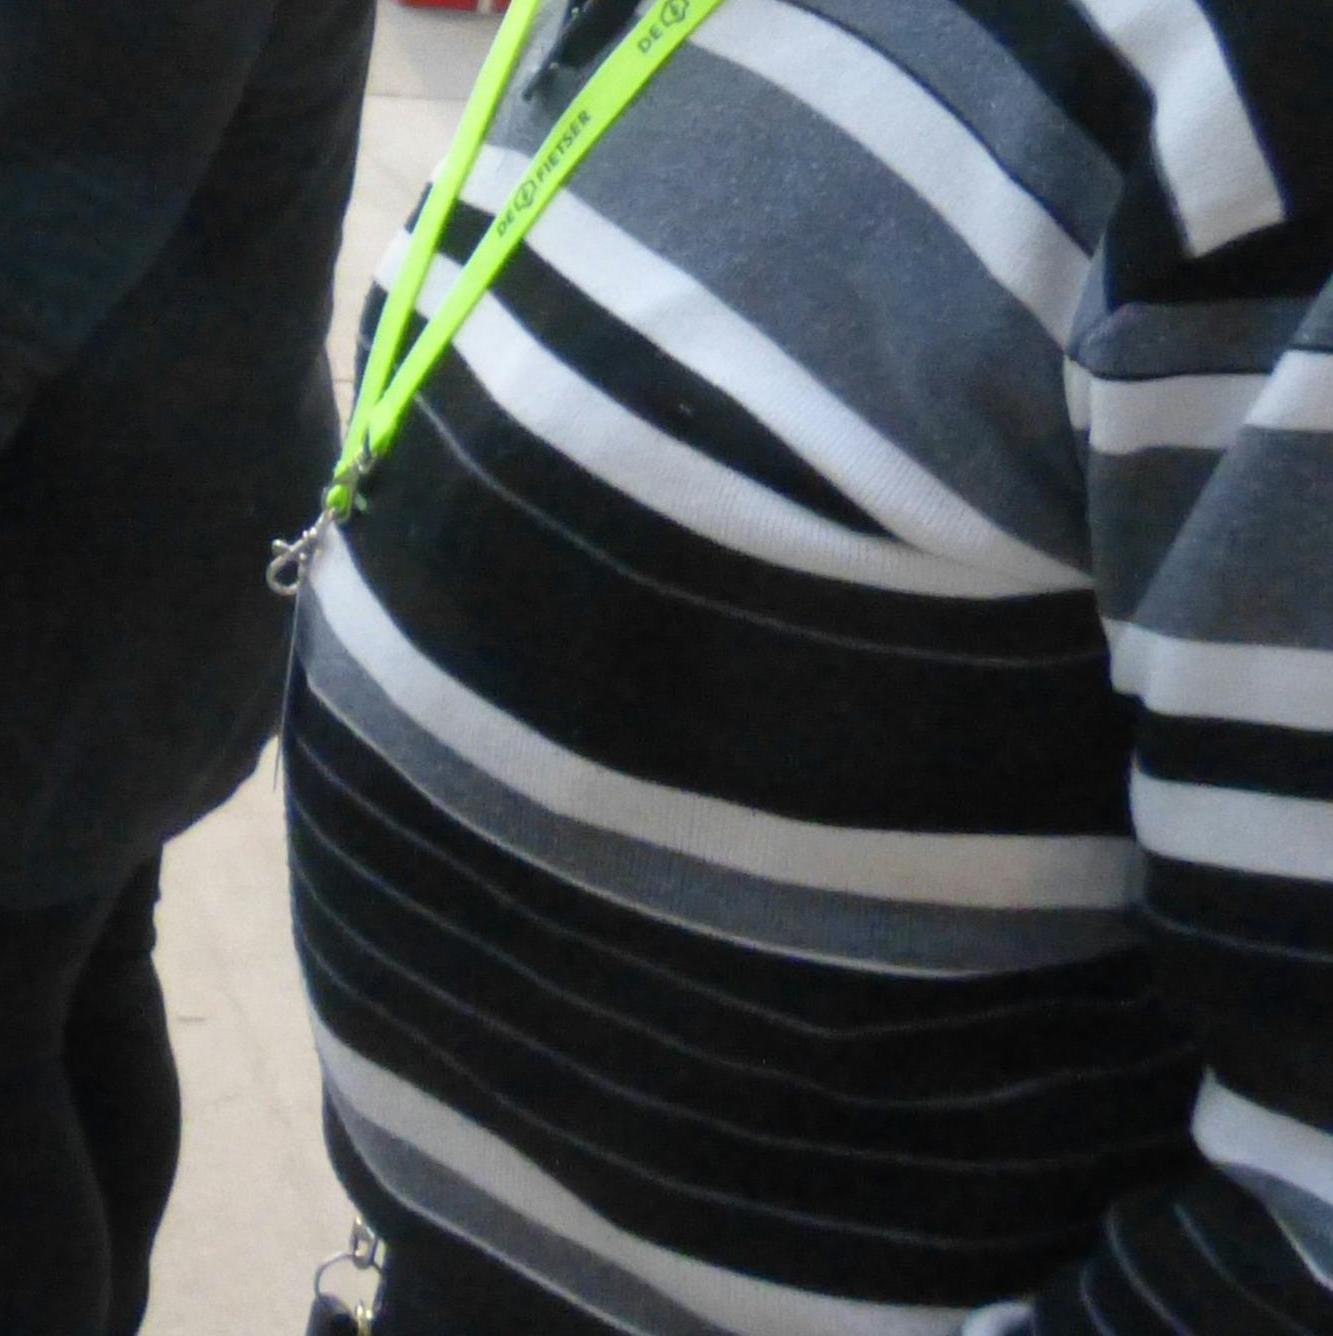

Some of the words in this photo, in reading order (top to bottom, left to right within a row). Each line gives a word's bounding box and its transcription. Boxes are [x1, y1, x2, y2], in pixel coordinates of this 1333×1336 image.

[637, 25, 663, 55] DE
[497, 207, 516, 238] DE
[535, 109, 592, 184] FIETSER
